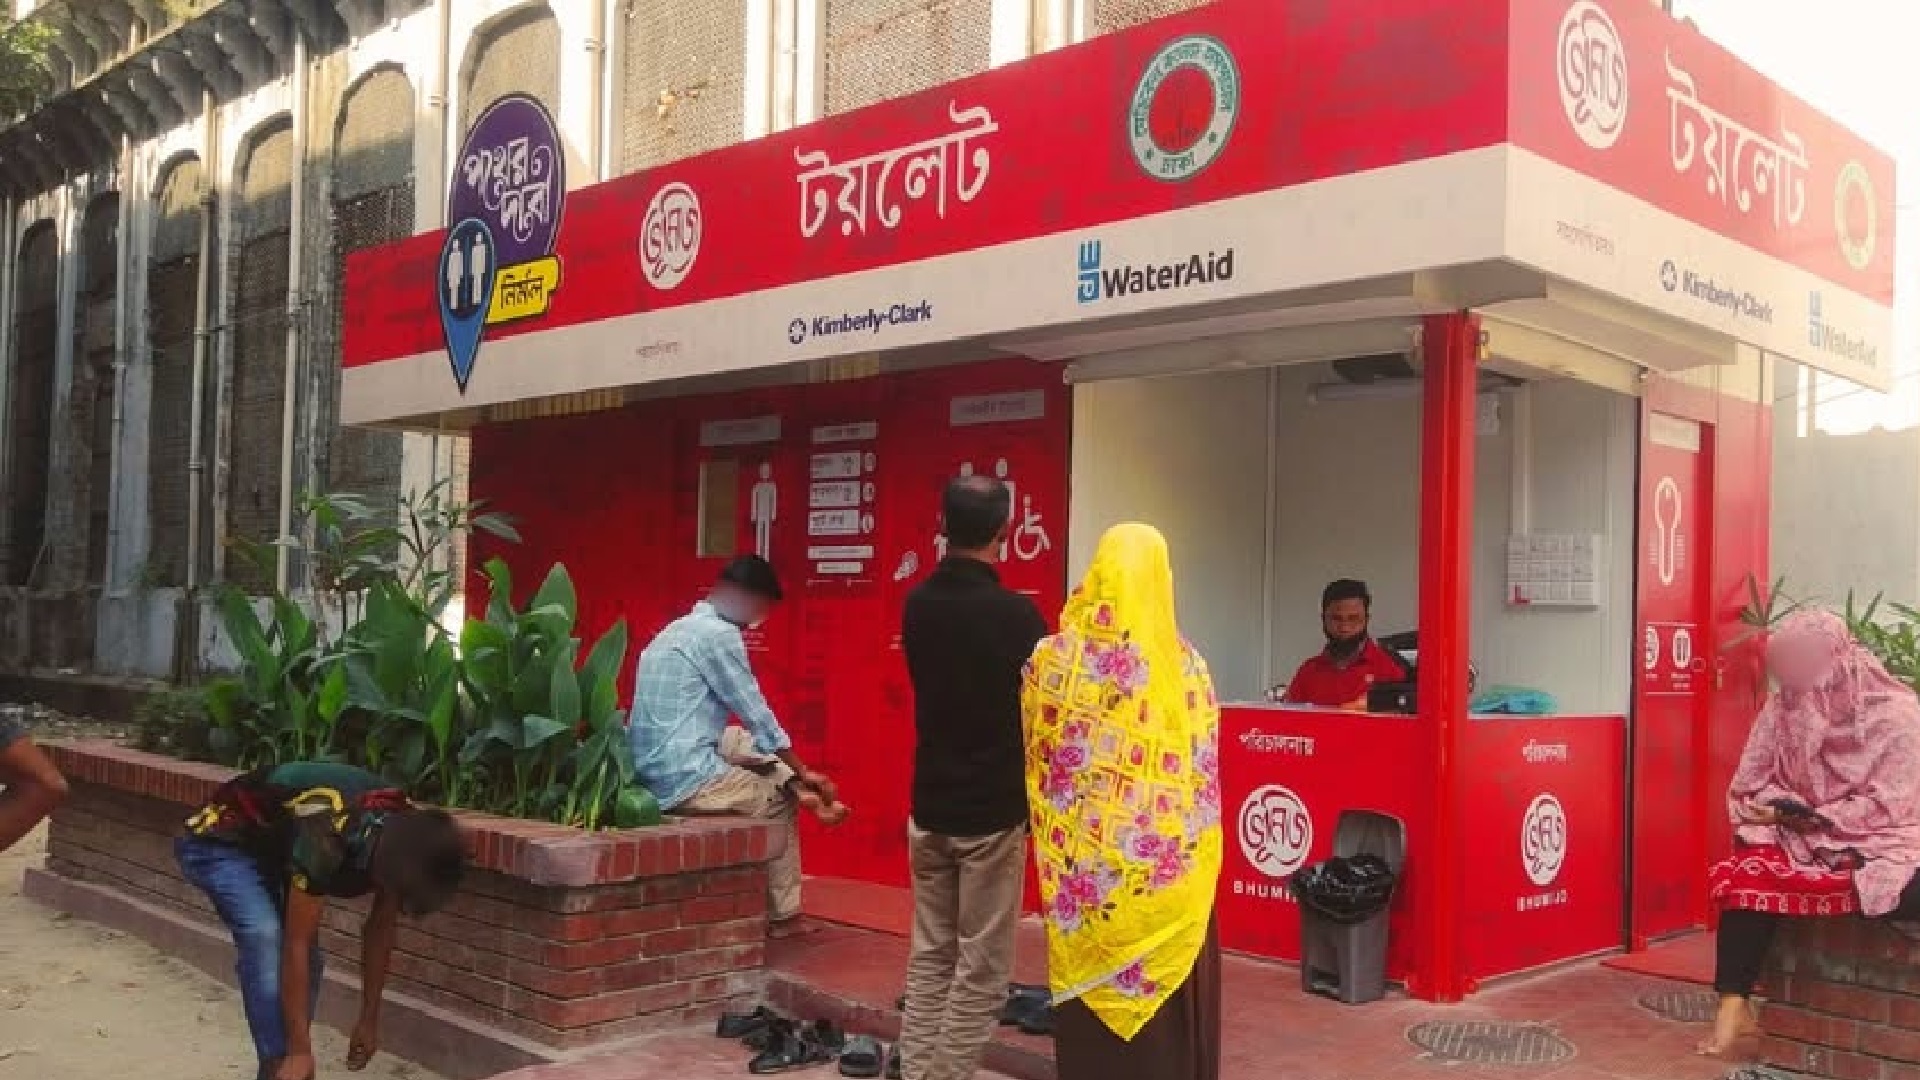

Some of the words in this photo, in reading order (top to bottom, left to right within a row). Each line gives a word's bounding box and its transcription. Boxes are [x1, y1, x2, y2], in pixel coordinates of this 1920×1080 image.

[1666, 45, 1809, 231] টয়লেট
[794, 100, 998, 237] টয়লেট
[501, 269, 545, 309] নির্মল
[1102, 248, 1234, 299] WaterAid
[1682, 269, 1773, 324] Kimberly-Clark
[812, 299, 933, 337] Kimberly-Clark
[1233, 880, 1298, 903] BHUMI
